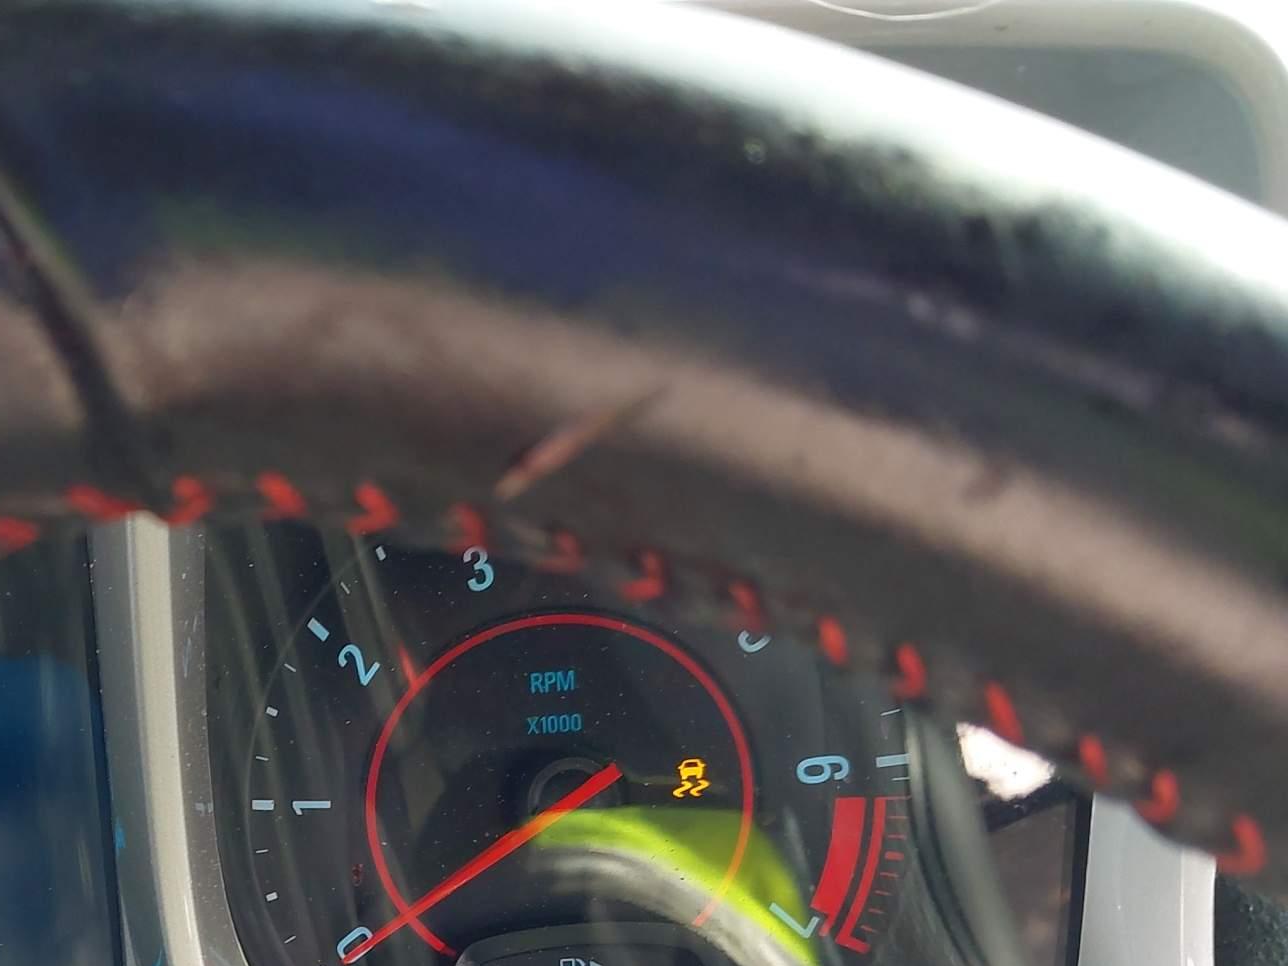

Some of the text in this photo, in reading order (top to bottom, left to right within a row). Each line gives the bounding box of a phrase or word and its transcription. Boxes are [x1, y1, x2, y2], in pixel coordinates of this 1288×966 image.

[463, 545, 496, 592] 3
[338, 643, 381, 687] 2
[530, 670, 576, 694] RPM
[526, 712, 582, 736] X1000
[795, 755, 850, 785] 6
[292, 800, 332, 816] 1
[769, 902, 820, 939] 7
[336, 926, 373, 964] 0
